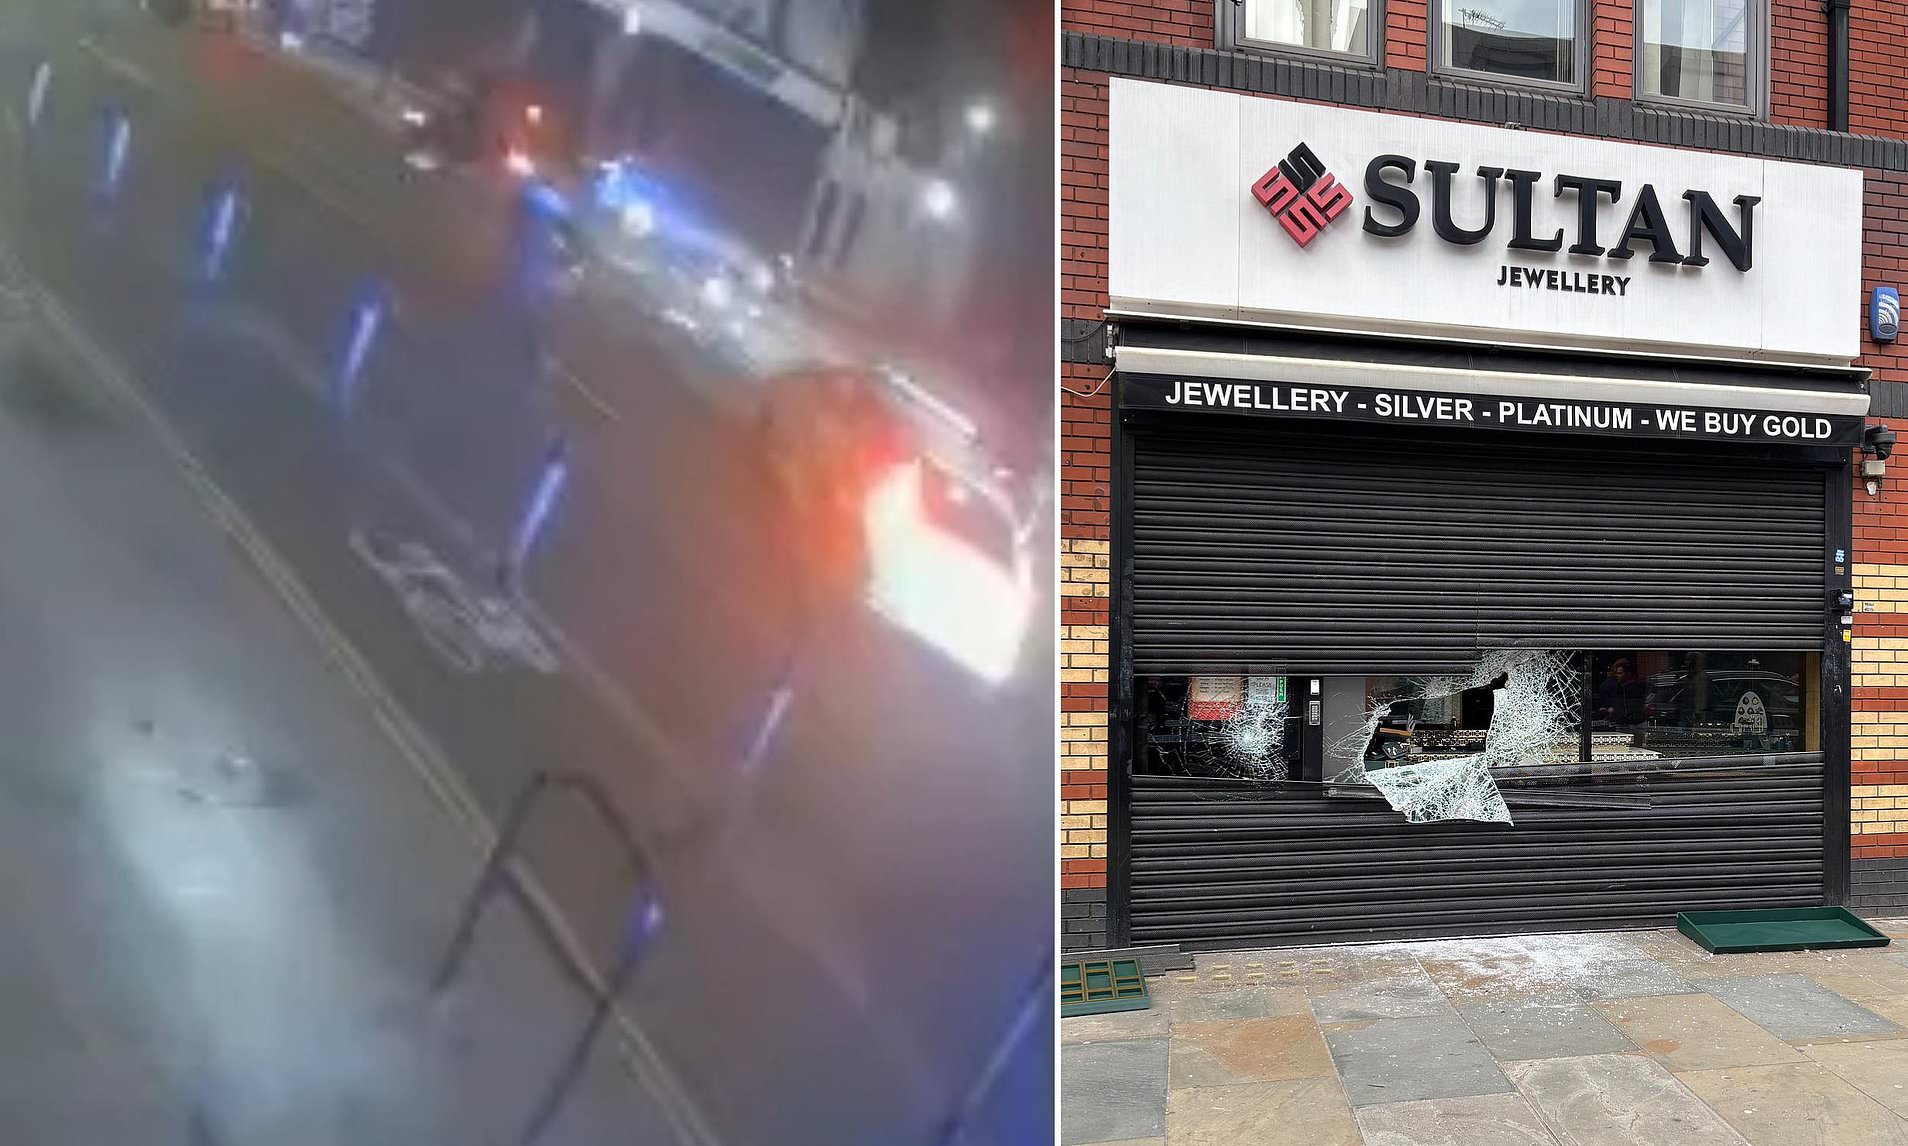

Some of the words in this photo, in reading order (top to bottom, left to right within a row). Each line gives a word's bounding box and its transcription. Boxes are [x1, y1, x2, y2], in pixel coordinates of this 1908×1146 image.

[1362, 153, 1762, 273] SULTAN
[1497, 265, 1632, 297] JEWELLERY
[1165, 381, 1349, 413] JEWELLERY
[1374, 393, 1475, 421] SILVER
[1499, 401, 1632, 430] PLATINUM
[1655, 409, 1697, 432] WE
[1704, 412, 1757, 435] BUY
[1762, 415, 1832, 439] GOLD
